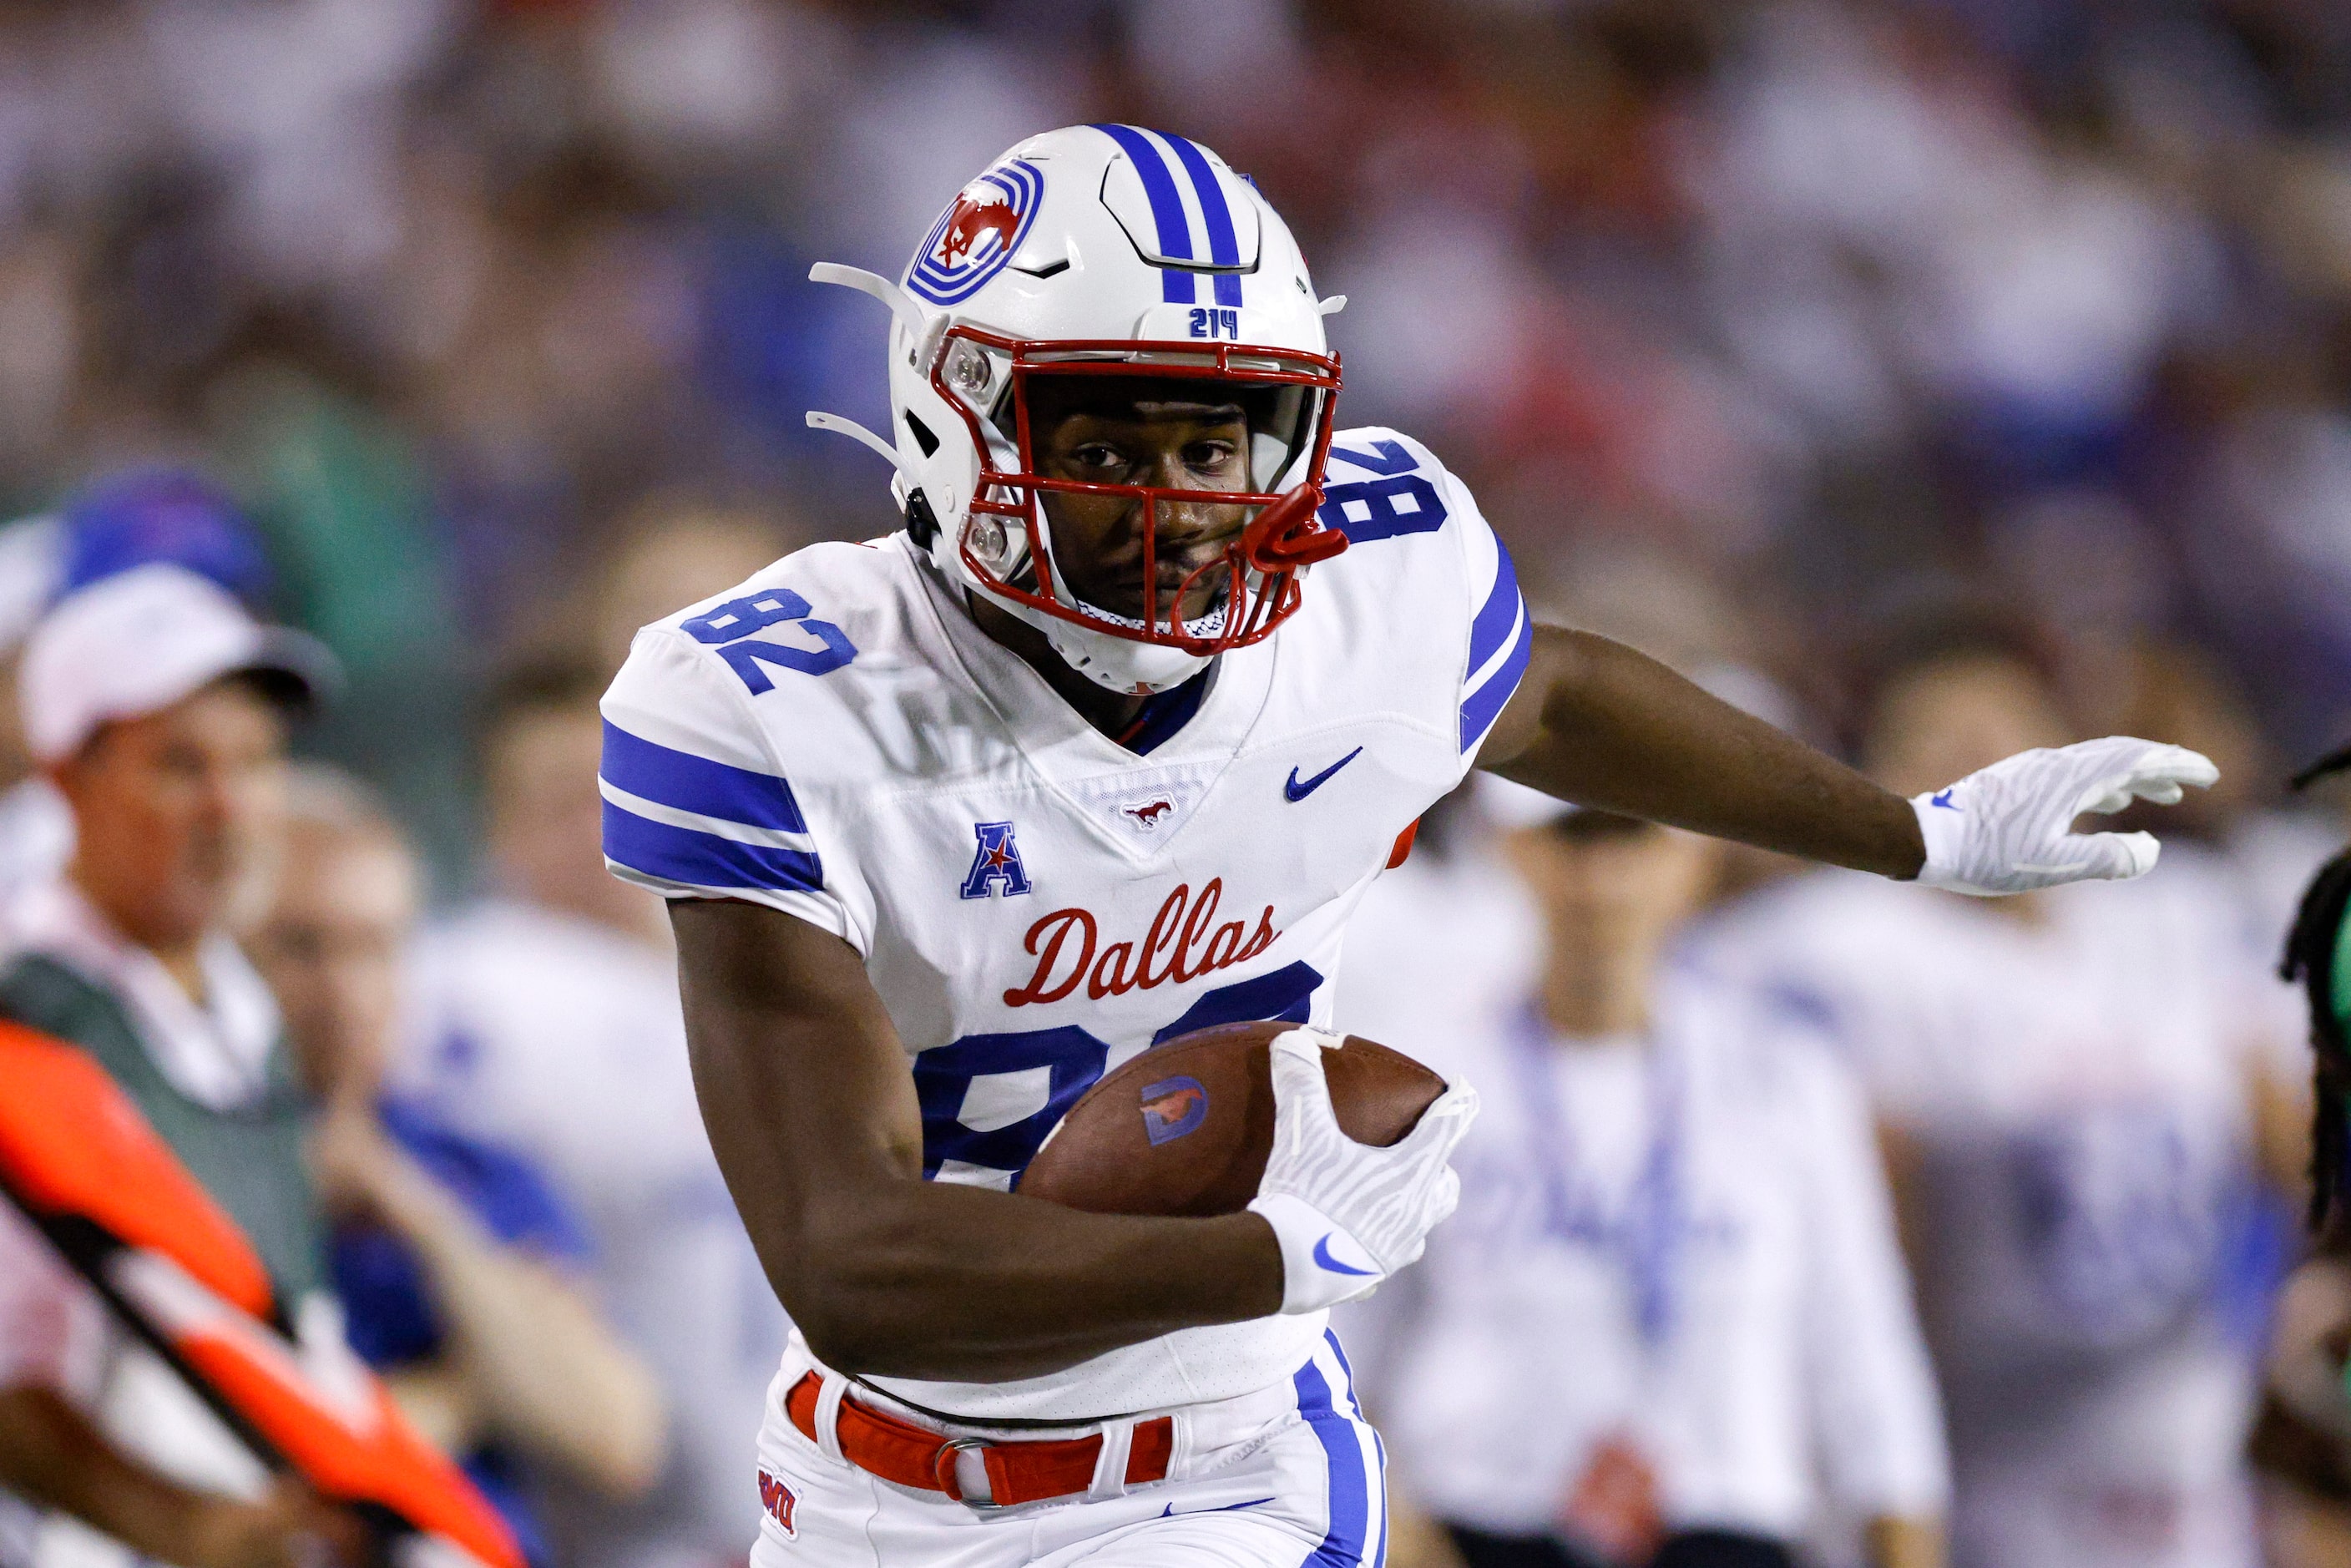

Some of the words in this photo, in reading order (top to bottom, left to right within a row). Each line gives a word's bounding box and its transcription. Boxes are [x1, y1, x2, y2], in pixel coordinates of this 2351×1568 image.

[1189, 308, 1238, 340] 214
[679, 588, 858, 695] 82
[960, 821, 1032, 899] A
[1004, 877, 1282, 1007] Dallas
